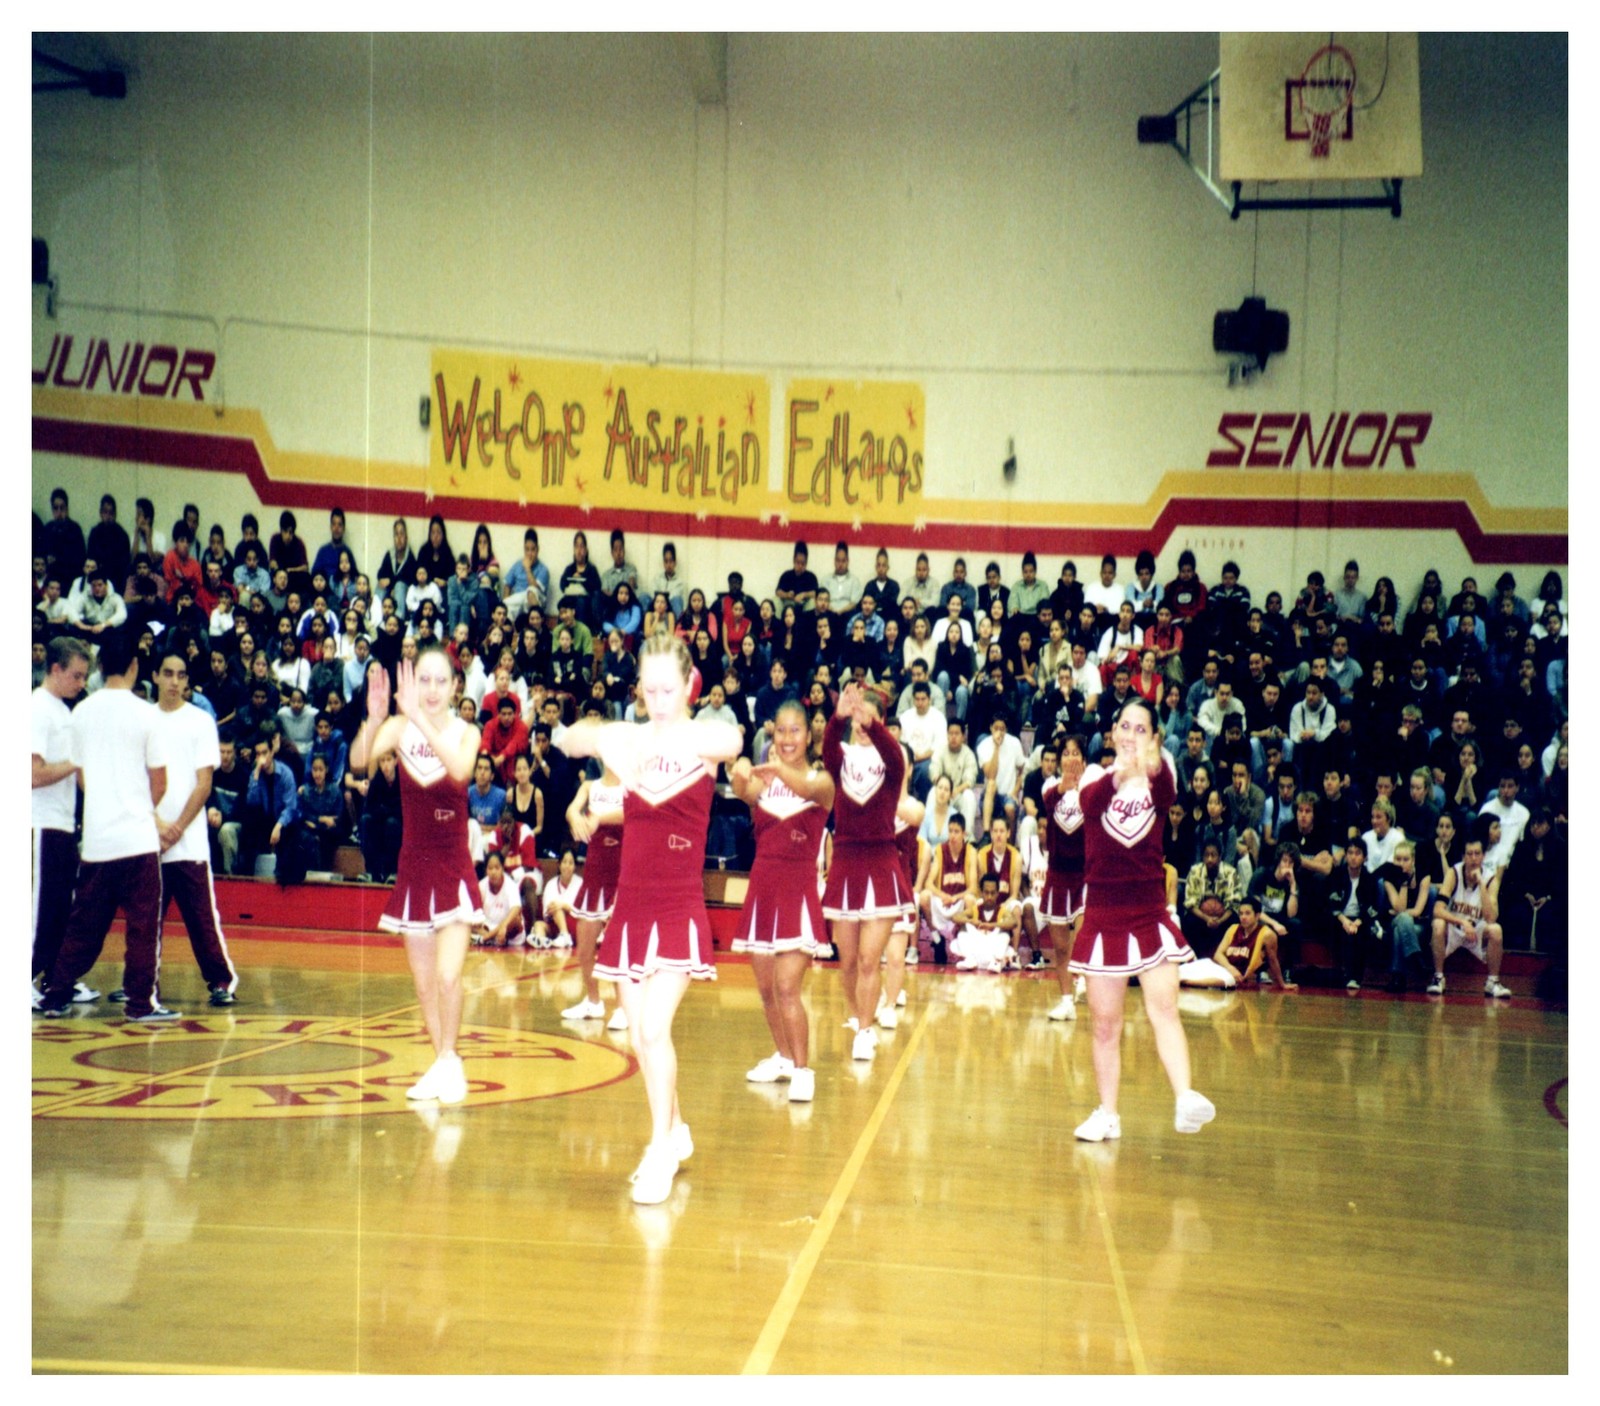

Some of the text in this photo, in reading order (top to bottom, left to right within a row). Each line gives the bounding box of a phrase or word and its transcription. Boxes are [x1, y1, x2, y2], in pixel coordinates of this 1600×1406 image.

[32, 334, 215, 401] JUNIOR
[435, 371, 586, 488] Welcome
[787, 399, 923, 506] Educators
[1206, 412, 1432, 469] SENIOR
